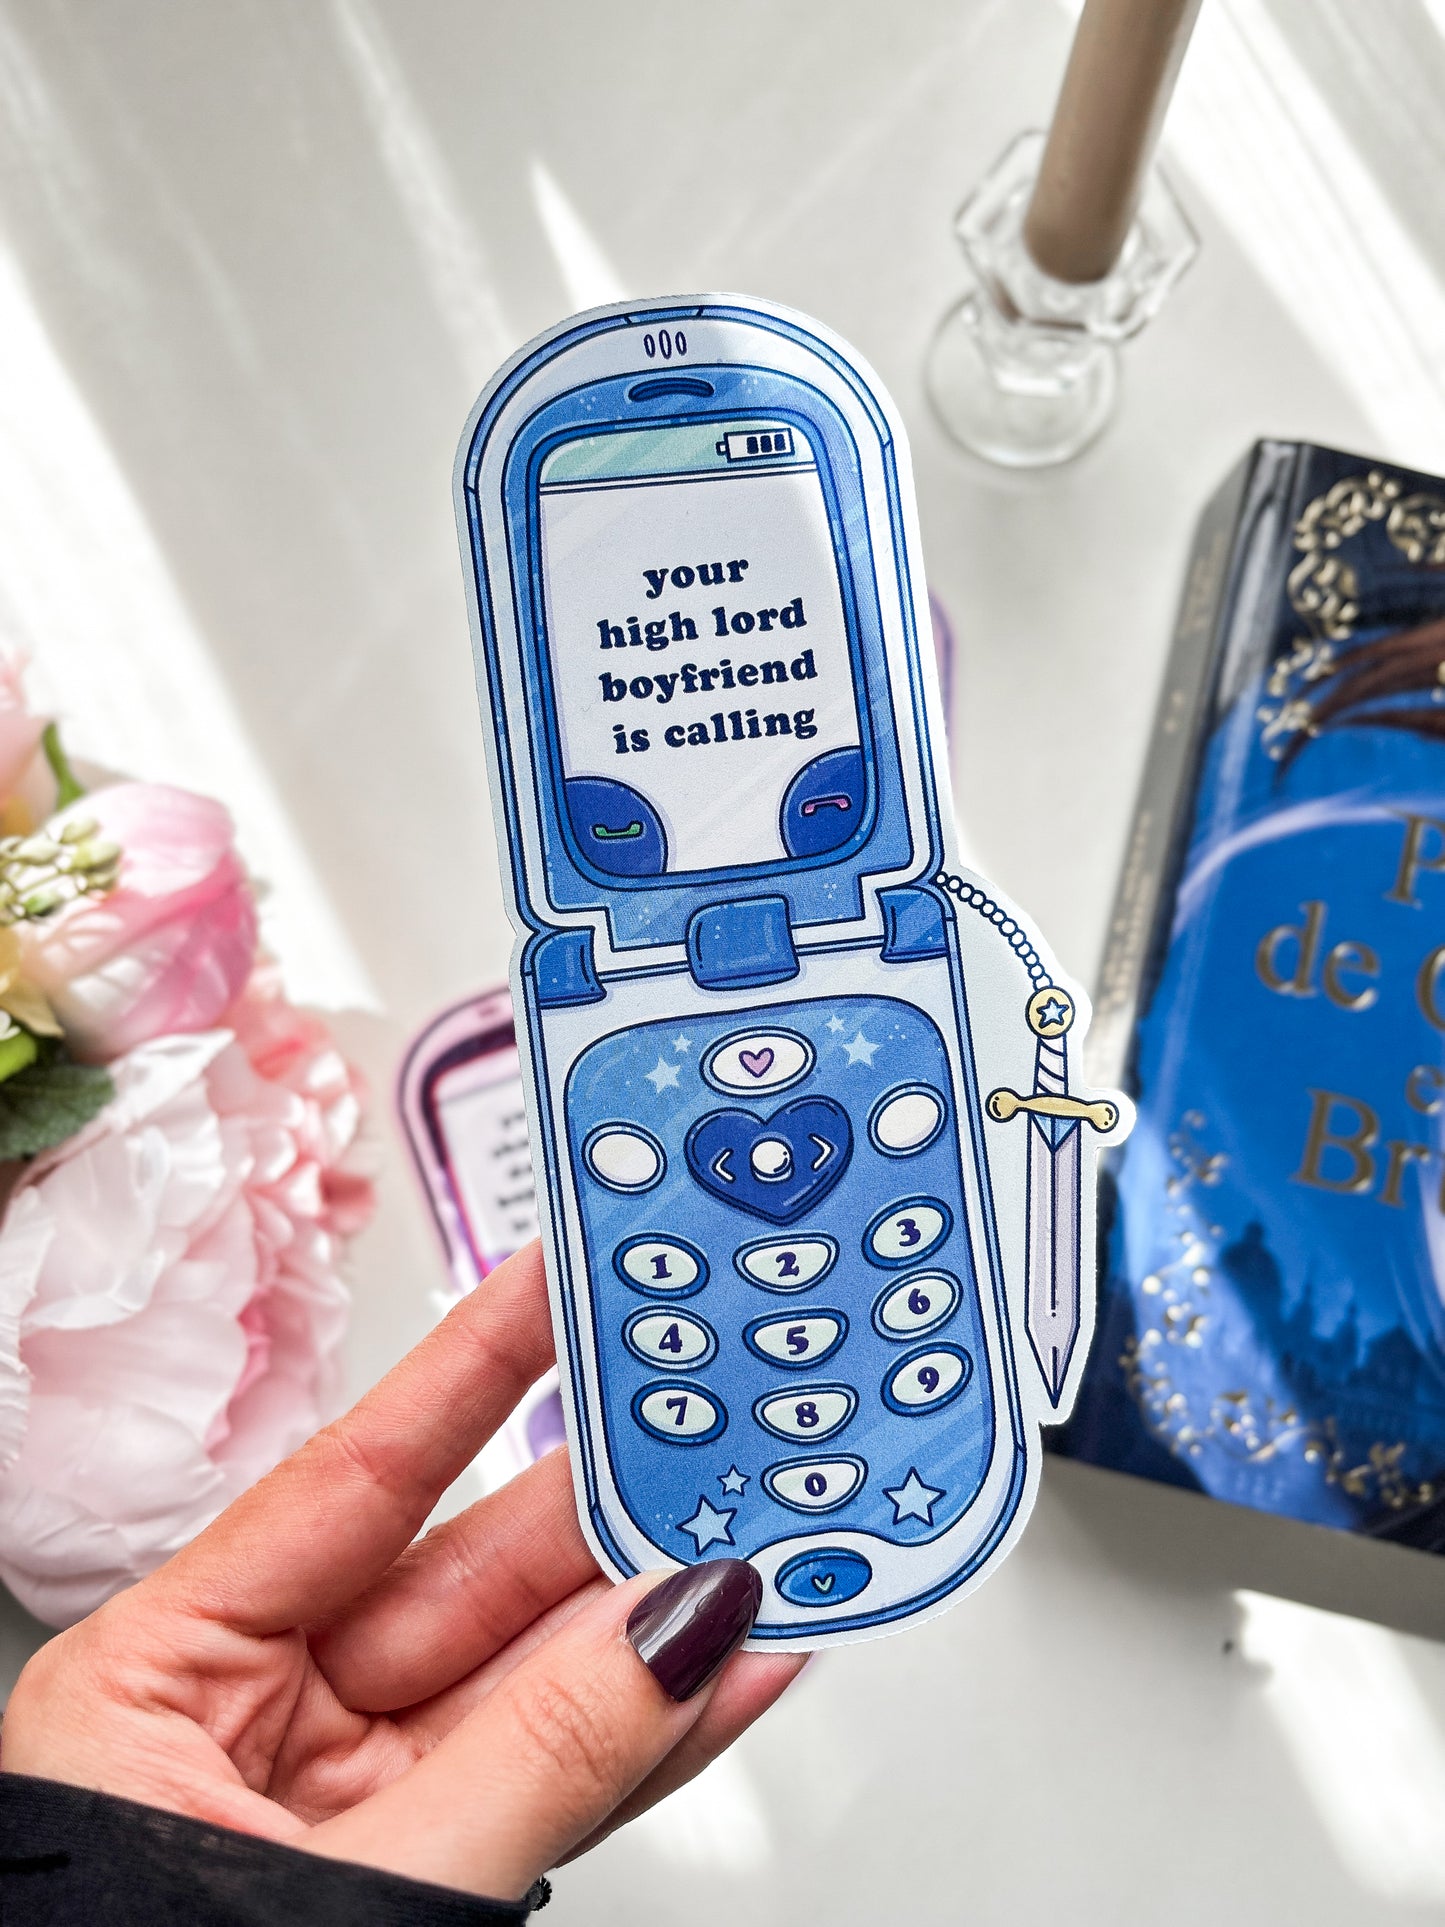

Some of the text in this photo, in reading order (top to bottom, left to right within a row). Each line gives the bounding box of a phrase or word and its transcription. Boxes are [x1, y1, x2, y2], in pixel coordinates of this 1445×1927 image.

[643, 559, 749, 599] your
[597, 597, 807, 651] high lord
[599, 649, 818, 704] boyfriend
[612, 708, 818, 754] is calling
[1256, 899, 1379, 1011] de
[1289, 1087, 1445, 1214] Br
[650, 1218, 922, 1279] 1 2 3
[658, 1288, 931, 1355] 4 5 6
[666, 1366, 940, 1428] 7 8 9
[804, 1472, 828, 1497] 0
